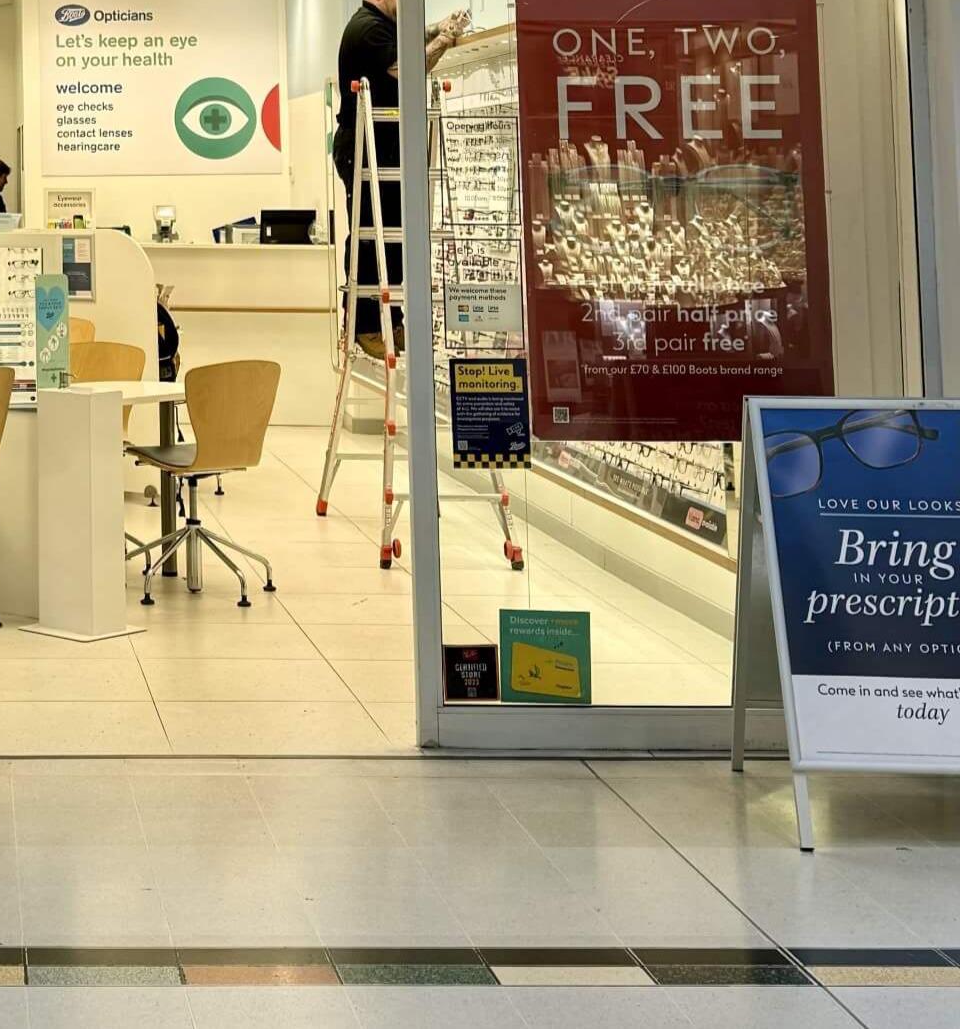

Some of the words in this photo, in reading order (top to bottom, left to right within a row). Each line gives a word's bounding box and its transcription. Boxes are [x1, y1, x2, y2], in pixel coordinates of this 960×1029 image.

[93, 10, 154, 22] Opticians
[98, 33, 138, 50] keep
[143, 36, 164, 47] an
[169, 35, 198, 50] eye
[552, 27, 655, 60] ONE,
[674, 25, 786, 58] TWO,
[55, 55, 76, 67] on
[81, 55, 118, 70] your
[122, 52, 173, 67] health
[56, 81, 123, 94] welcome
[56, 103, 74, 113] eye
[77, 102, 114, 112] checks
[557, 75, 783, 139] FREE
[56, 114, 97, 126] glasses
[56, 128, 96, 138] contact
[99, 128, 133, 138] lenses
[57, 141, 121, 153] hearingcare
[581, 303, 620, 322] 2nd
[628, 305, 672, 327] pair
[676, 303, 720, 322] half
[726, 304, 778, 327] price
[612, 331, 647, 351] 3rd
[655, 333, 696, 356] pair
[458, 365, 485, 377] Stop!
[488, 366, 510, 376] Live
[609, 367, 628, 375] our
[630, 364, 650, 375] £70
[652, 365, 660, 375] &
[662, 364, 686, 375] £100
[689, 365, 718, 375] Boots
[720, 365, 751, 376] brand
[753, 367, 784, 378] range
[818, 498, 859, 510] LOVE
[866, 499, 901, 511] OUR
[909, 500, 960, 512] LOOKS
[834, 528, 956, 580] Bring
[854, 573, 870, 583] IN
[878, 573, 923, 584] YOUR
[510, 616, 548, 624] Discover
[510, 627, 545, 635] rewards
[828, 641, 876, 653] (FROM
[882, 643, 912, 653] ANY
[817, 684, 856, 696] Come
[859, 685, 871, 696] in
[874, 686, 899, 698] and
[902, 689, 923, 698] see
[897, 703, 950, 725] today
